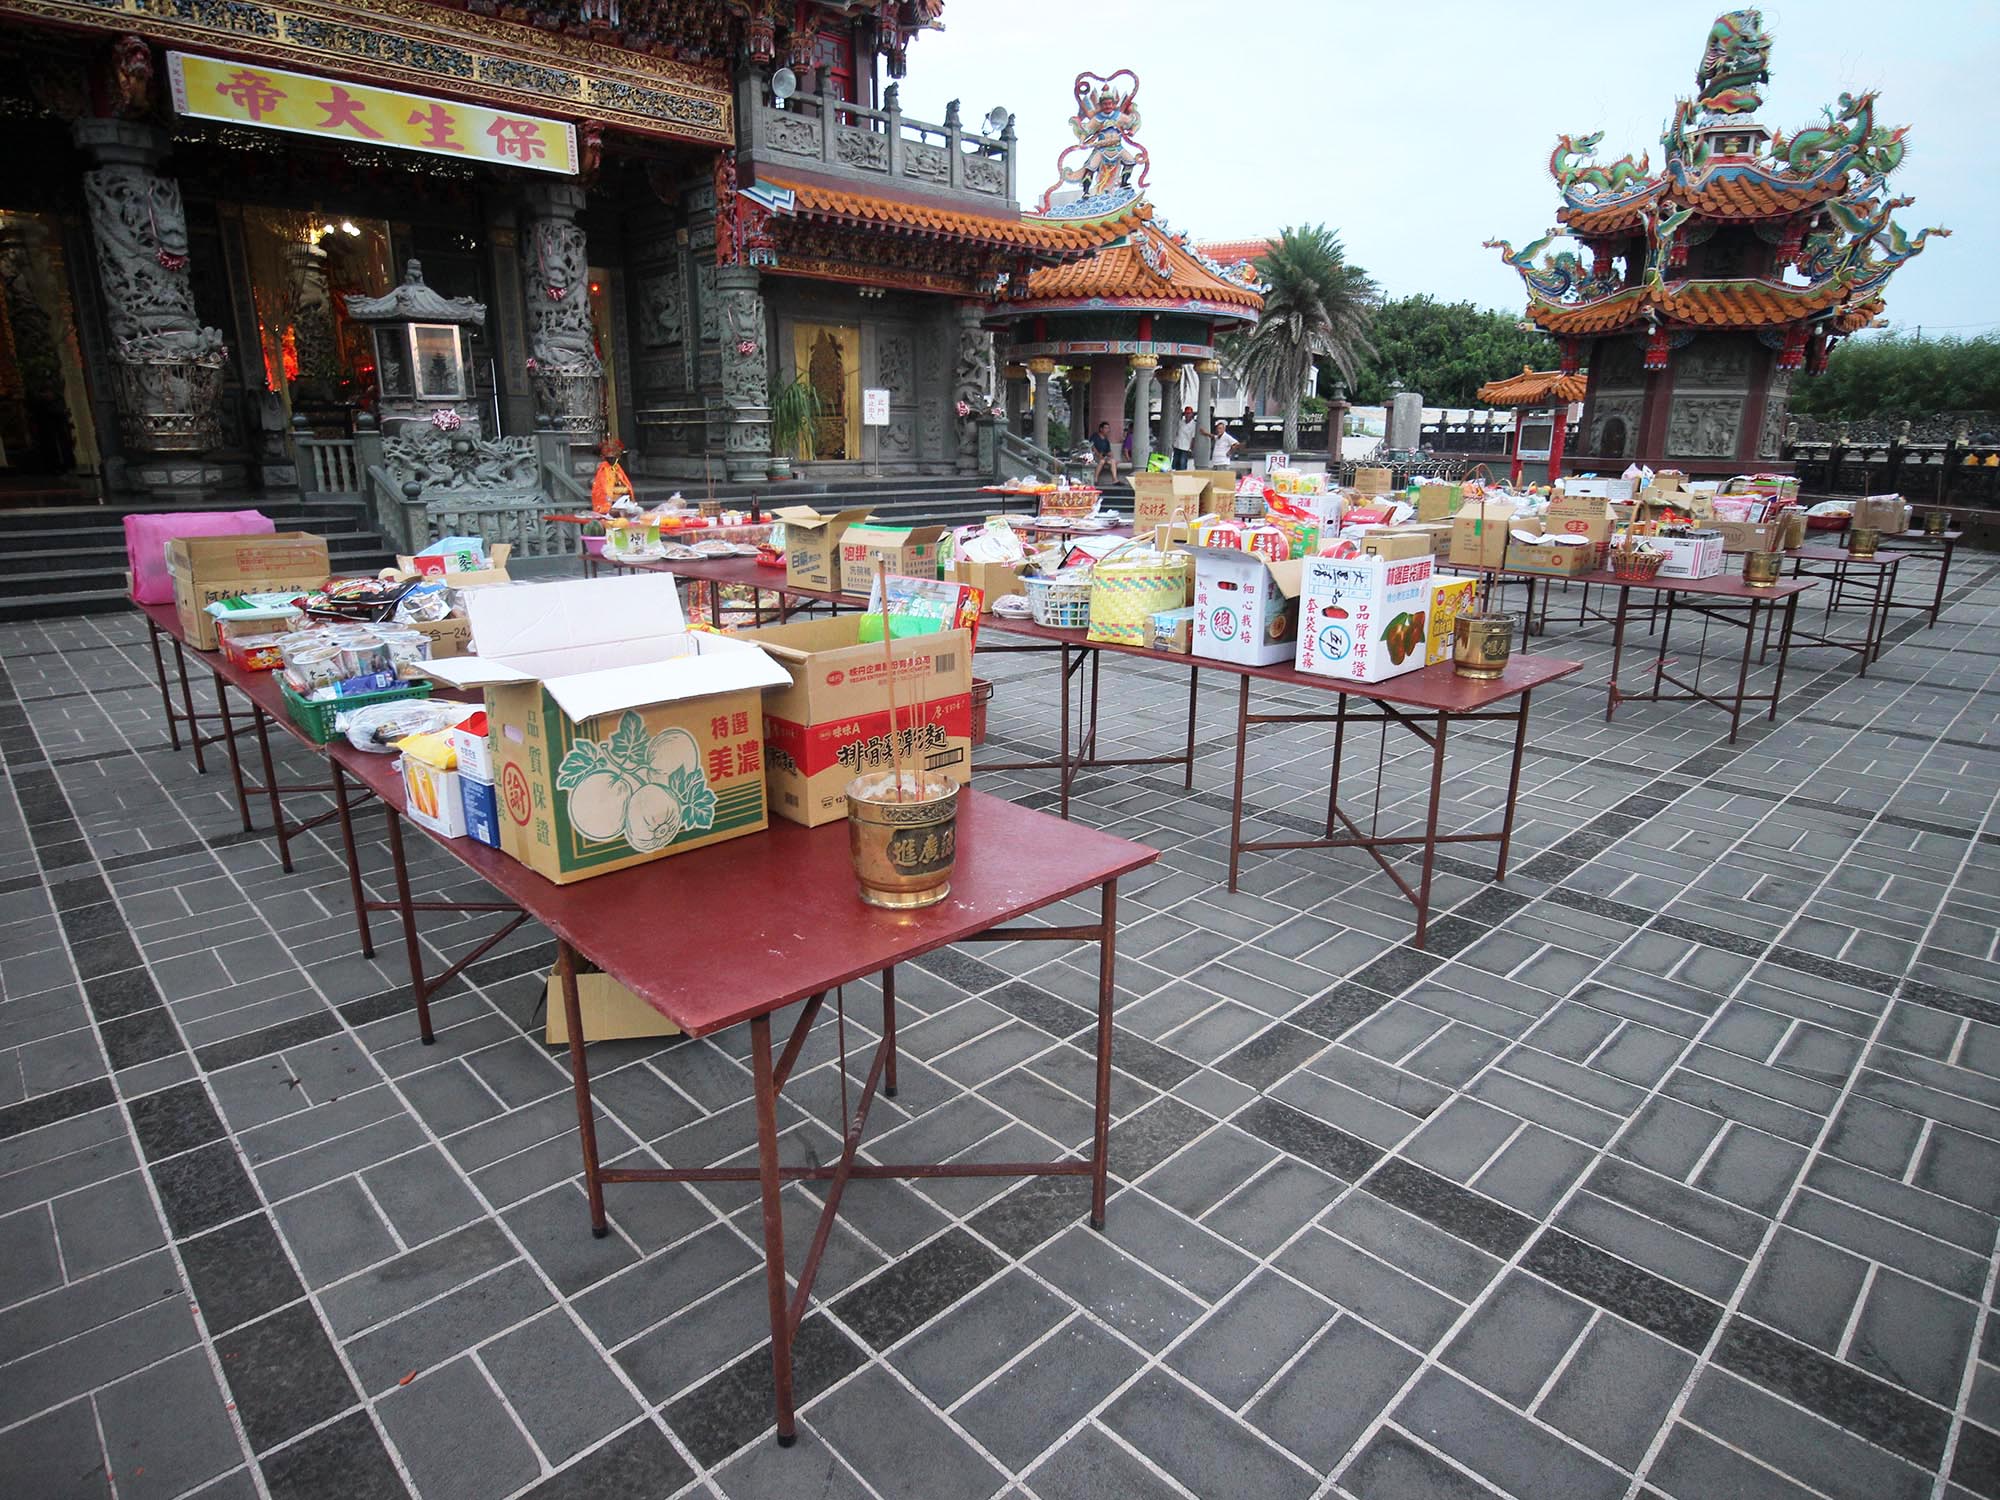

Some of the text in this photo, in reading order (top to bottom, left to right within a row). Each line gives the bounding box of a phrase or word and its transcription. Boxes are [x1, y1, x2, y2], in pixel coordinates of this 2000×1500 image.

[1351, 604, 1370, 678] 品質保證
[710, 711, 749, 740] 特選
[526, 710, 551, 847] 品質保證
[707, 739, 761, 783] 美濃
